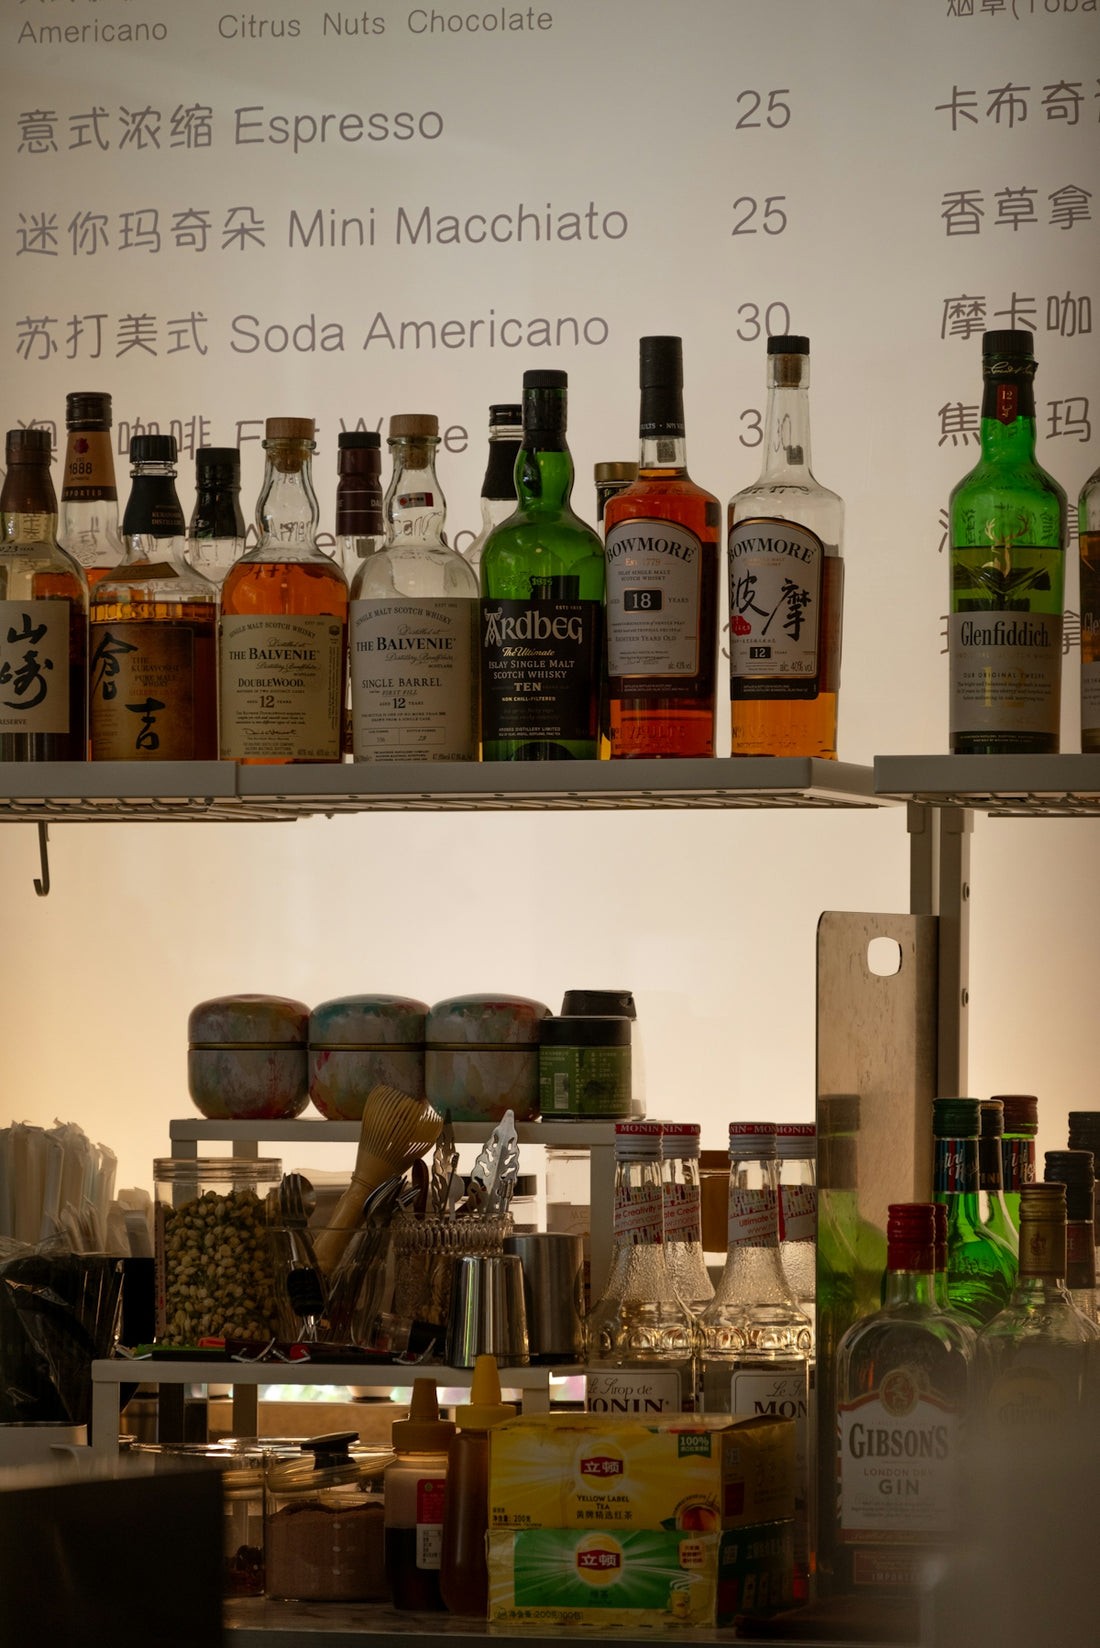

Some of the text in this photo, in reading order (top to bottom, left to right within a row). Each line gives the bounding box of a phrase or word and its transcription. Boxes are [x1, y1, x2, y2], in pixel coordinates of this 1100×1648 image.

[18, 7, 552, 43] Americano Citrus Nuts Chocolate
[736, 89, 790, 129] 25
[935, 79, 1100, 131] 卡布奇
[18, 103, 443, 154] 意式浓缩 Espresso
[732, 196, 787, 235] 25
[941, 184, 1092, 236] 香草拿
[16, 202, 628, 256] 迷你玛奇朵 Mini Macchiato
[735, 301, 790, 342] 30
[941, 291, 1092, 341] 摩卡咖
[16, 309, 608, 360] 苏打美式 Soda Americano
[937, 396, 1092, 447] 焦玛
[69, 463, 93, 475] 1888
[606, 537, 697, 564] BOWMORE
[632, 592, 652, 609] 18
[374, 607, 393, 618] MALT
[394, 606, 424, 616] SCOTCH
[425, 609, 453, 624] WHISKY
[960, 620, 1050, 648] Glenfiddich
[356, 637, 453, 652] THE BALVENIE
[229, 647, 318, 661] THE BALVENIE
[754, 648, 767, 658] 12
[489, 659, 576, 669] ISLAY SINGLE MALT
[238, 677, 306, 688] DOUBLEWOOD
[493, 670, 568, 680] SCOTCH WHISKY
[361, 677, 443, 689] SINGLE BARREL
[513, 682, 543, 692] TEN
[259, 694, 275, 709] 12
[392, 697, 407, 709] 12
[620, 1123, 660, 1134] MONIN
[637, 1385, 653, 1395] de
[588, 1398, 665, 1413] ONIN
[679, 1436, 710, 1446] 100%
[849, 1422, 949, 1460] GIBSON'S
[584, 1461, 620, 1473] 立顿
[863, 1468, 909, 1477] LONDON
[878, 1479, 920, 1495] GIN
[607, 1494, 630, 1502] LABEL
[580, 1554, 617, 1567] 立顿
